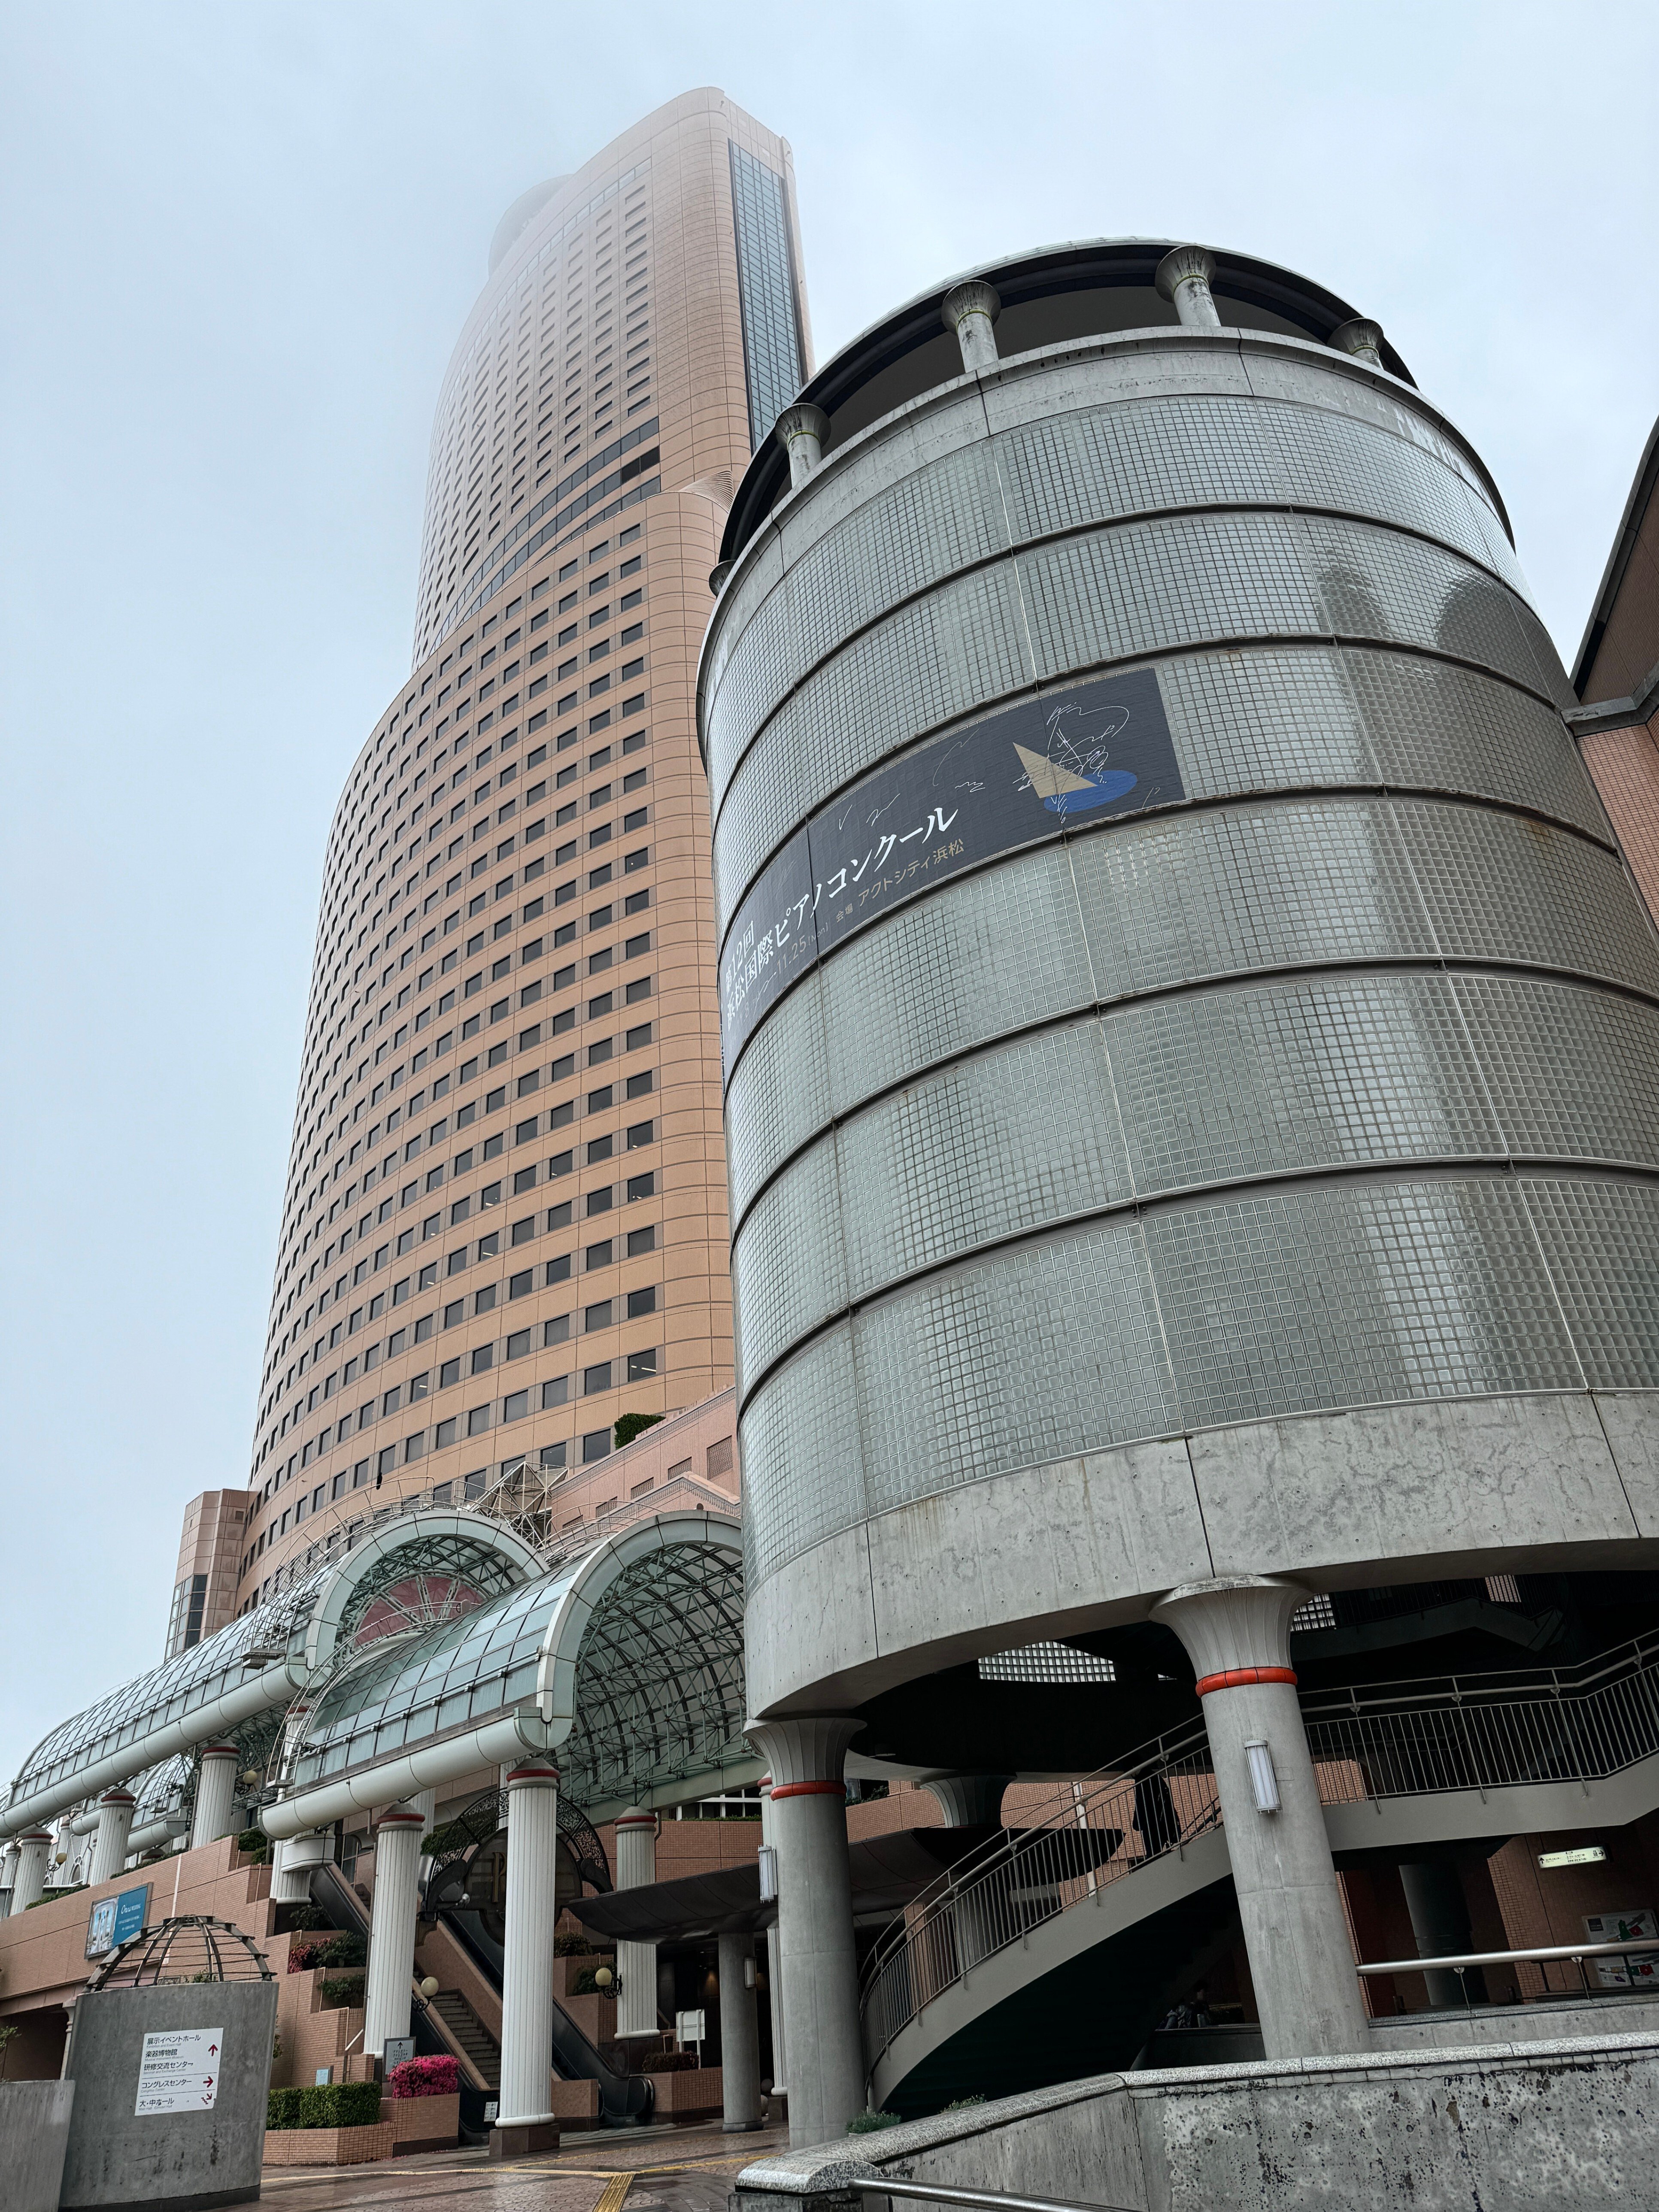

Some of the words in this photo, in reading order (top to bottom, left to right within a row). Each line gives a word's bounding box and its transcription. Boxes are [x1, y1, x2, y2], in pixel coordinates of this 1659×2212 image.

[836, 903, 853, 923] 会場
[858, 838, 964, 906] アクトシティ浜松
[147, 2034, 201, 2045] 展示イベントホール
[145, 2048, 178, 2058] 楽器博物館
[144, 2061, 194, 2071] 研修交流センター
[141, 2079, 192, 2089] コングレスセンター
[139, 2097, 175, 2107] 大・中ホール
